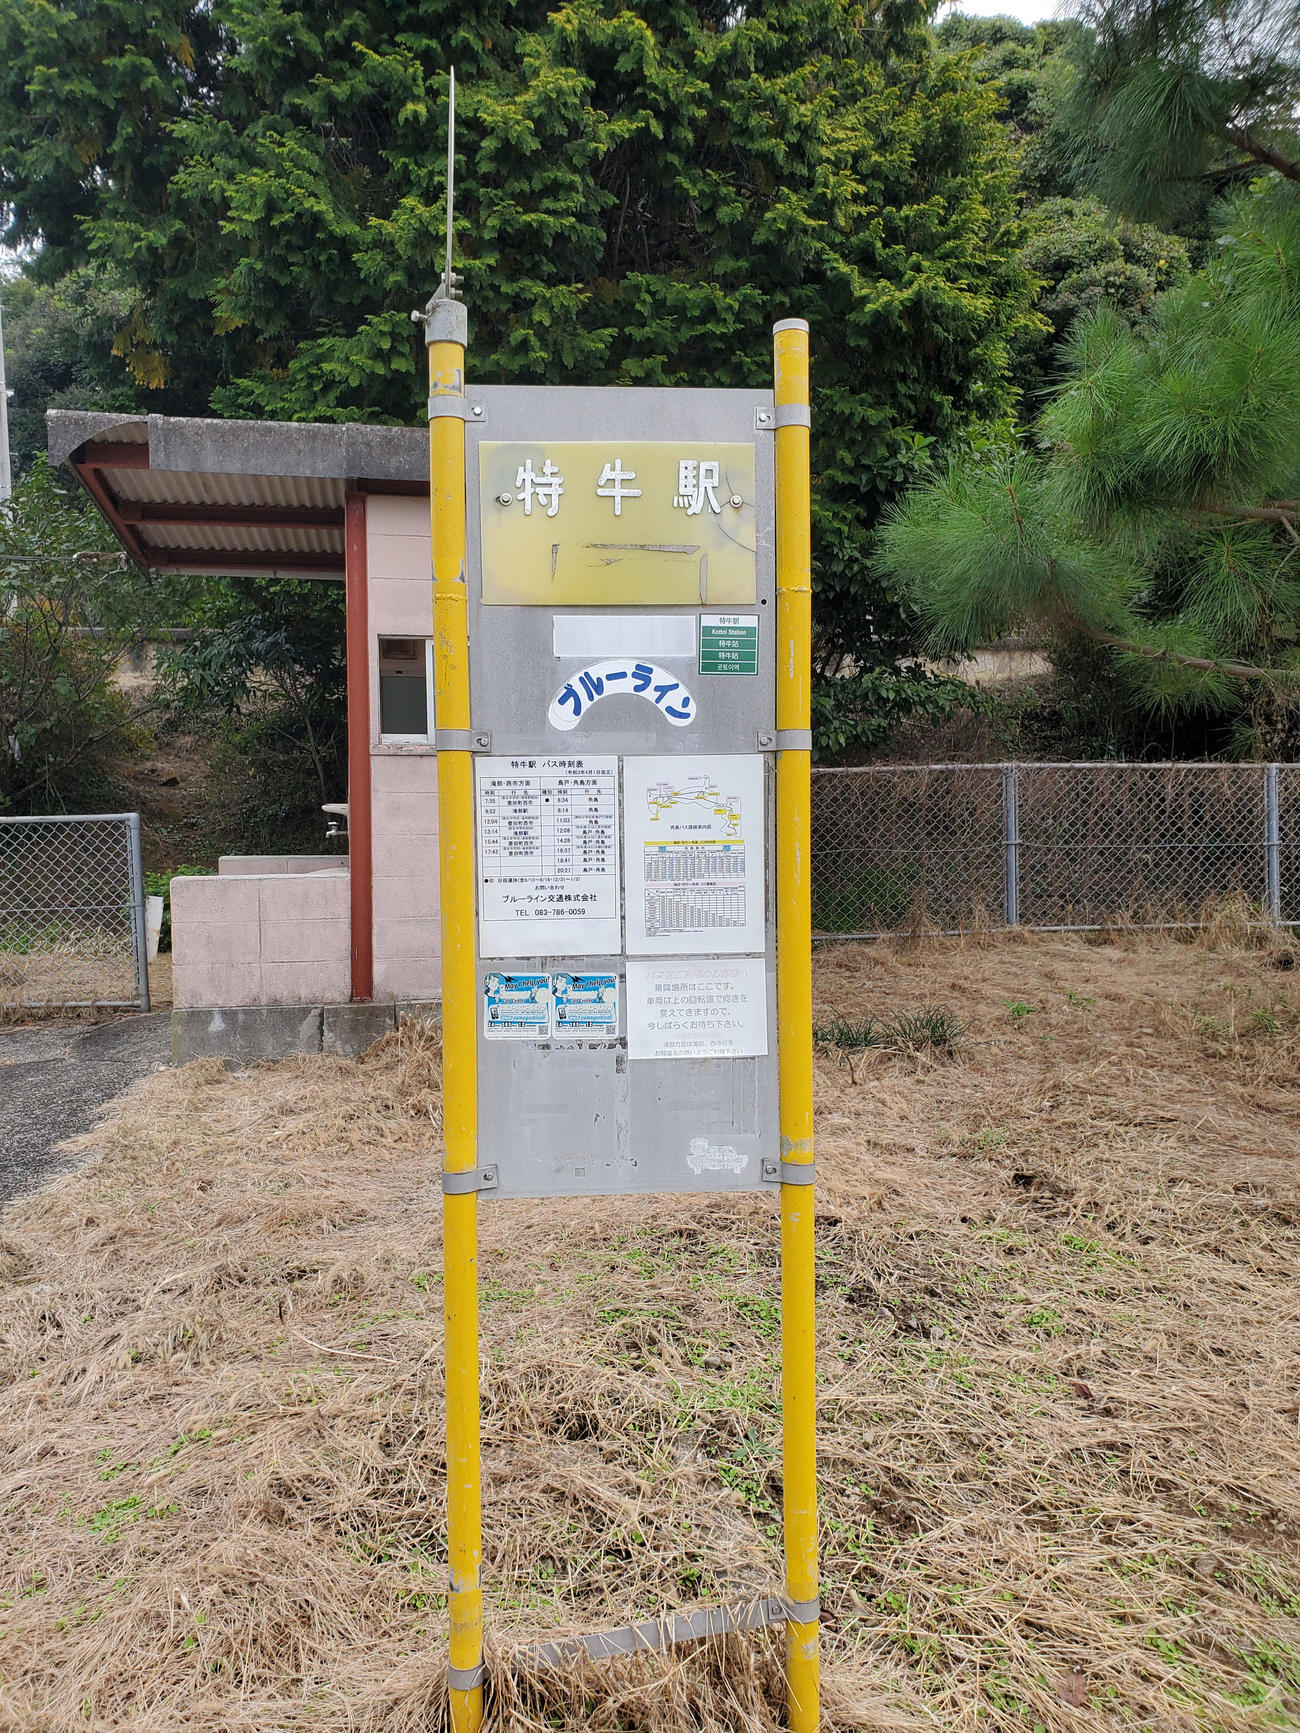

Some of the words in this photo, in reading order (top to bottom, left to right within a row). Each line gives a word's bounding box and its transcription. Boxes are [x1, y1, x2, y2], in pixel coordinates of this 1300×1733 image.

[515, 459, 719, 516] 特牛駅
[719, 617, 740, 625] 特牛駅
[718, 640, 739, 648] 特牛站
[558, 664, 691, 719] ブルーライン
[511, 760, 537, 769] 特牛駅
[542, 760, 584, 768] バス時刻表
[502, 893, 598, 903] ブルーライン交通株式会社
[534, 908, 586, 916] 083-786-0059
[660, 1008, 730, 1018] 変えてきますので、
[647, 1020, 744, 1030] 今しばらくお待ち下さい。
